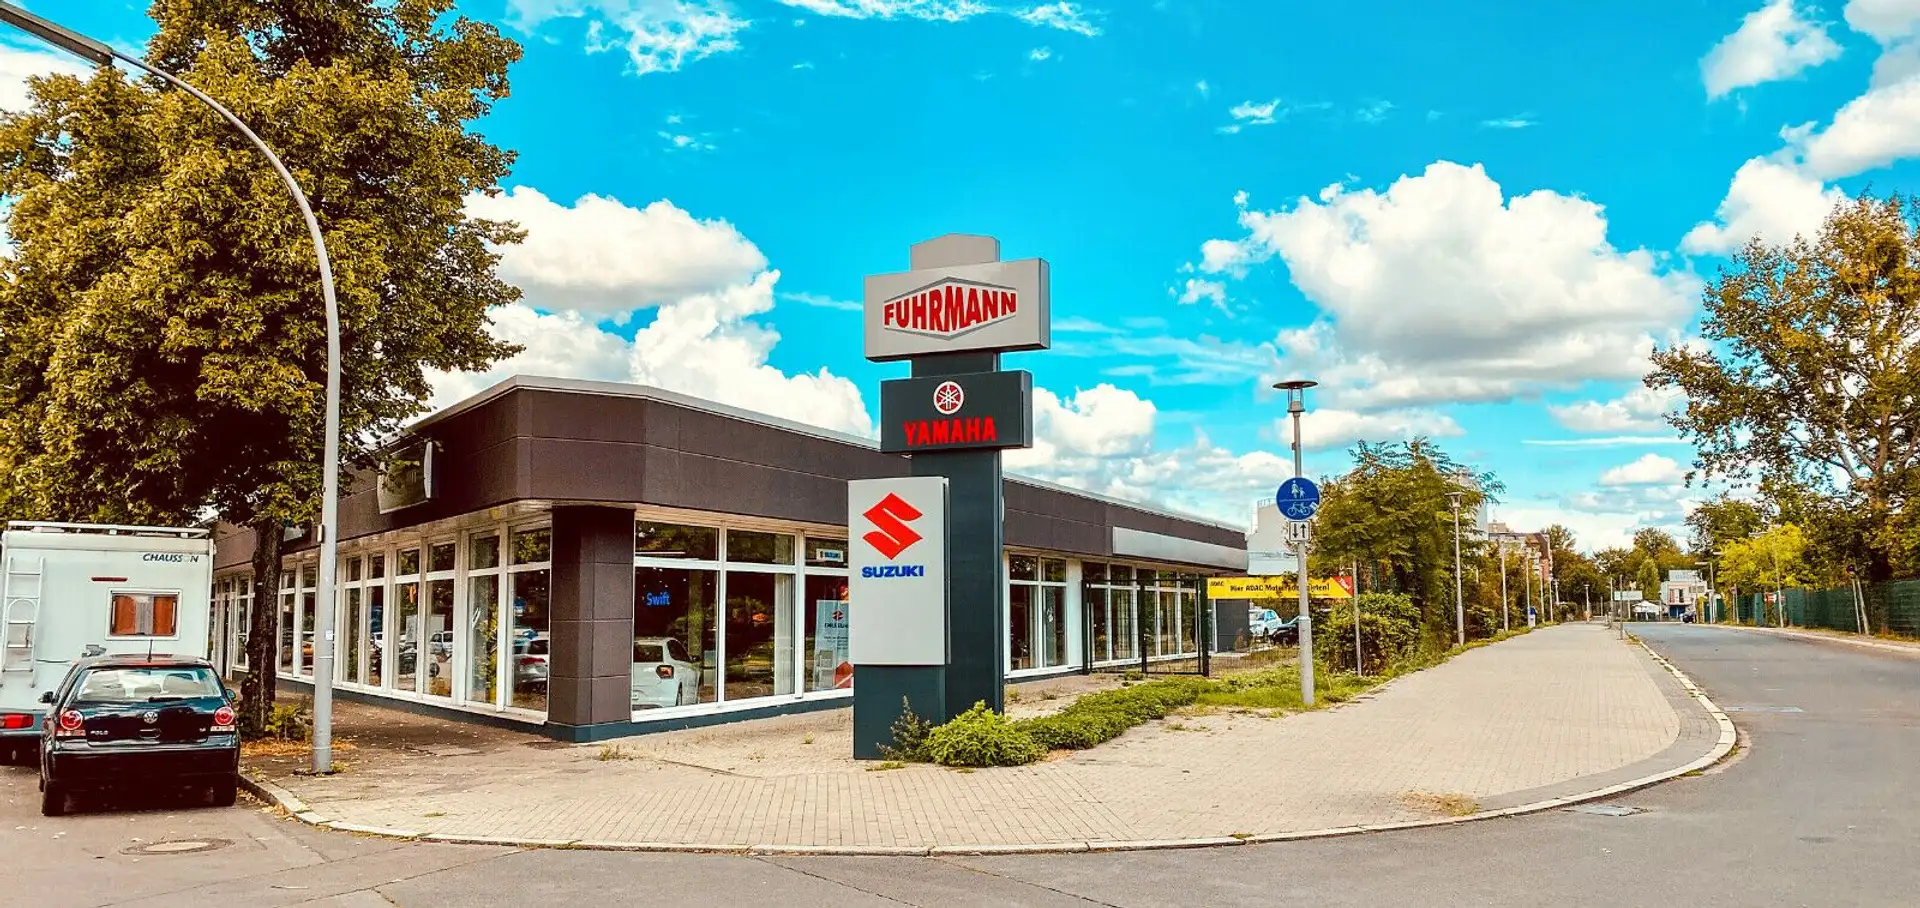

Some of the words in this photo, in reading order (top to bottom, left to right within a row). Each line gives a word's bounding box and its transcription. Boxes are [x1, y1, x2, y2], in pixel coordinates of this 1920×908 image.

[884, 286, 1016, 332] FUHRMANN
[904, 416, 996, 445] YAMAHA
[142, 553, 199, 563] CHAUSSN
[862, 565, 924, 578] SUZUKI
[646, 591, 671, 606] Swift
